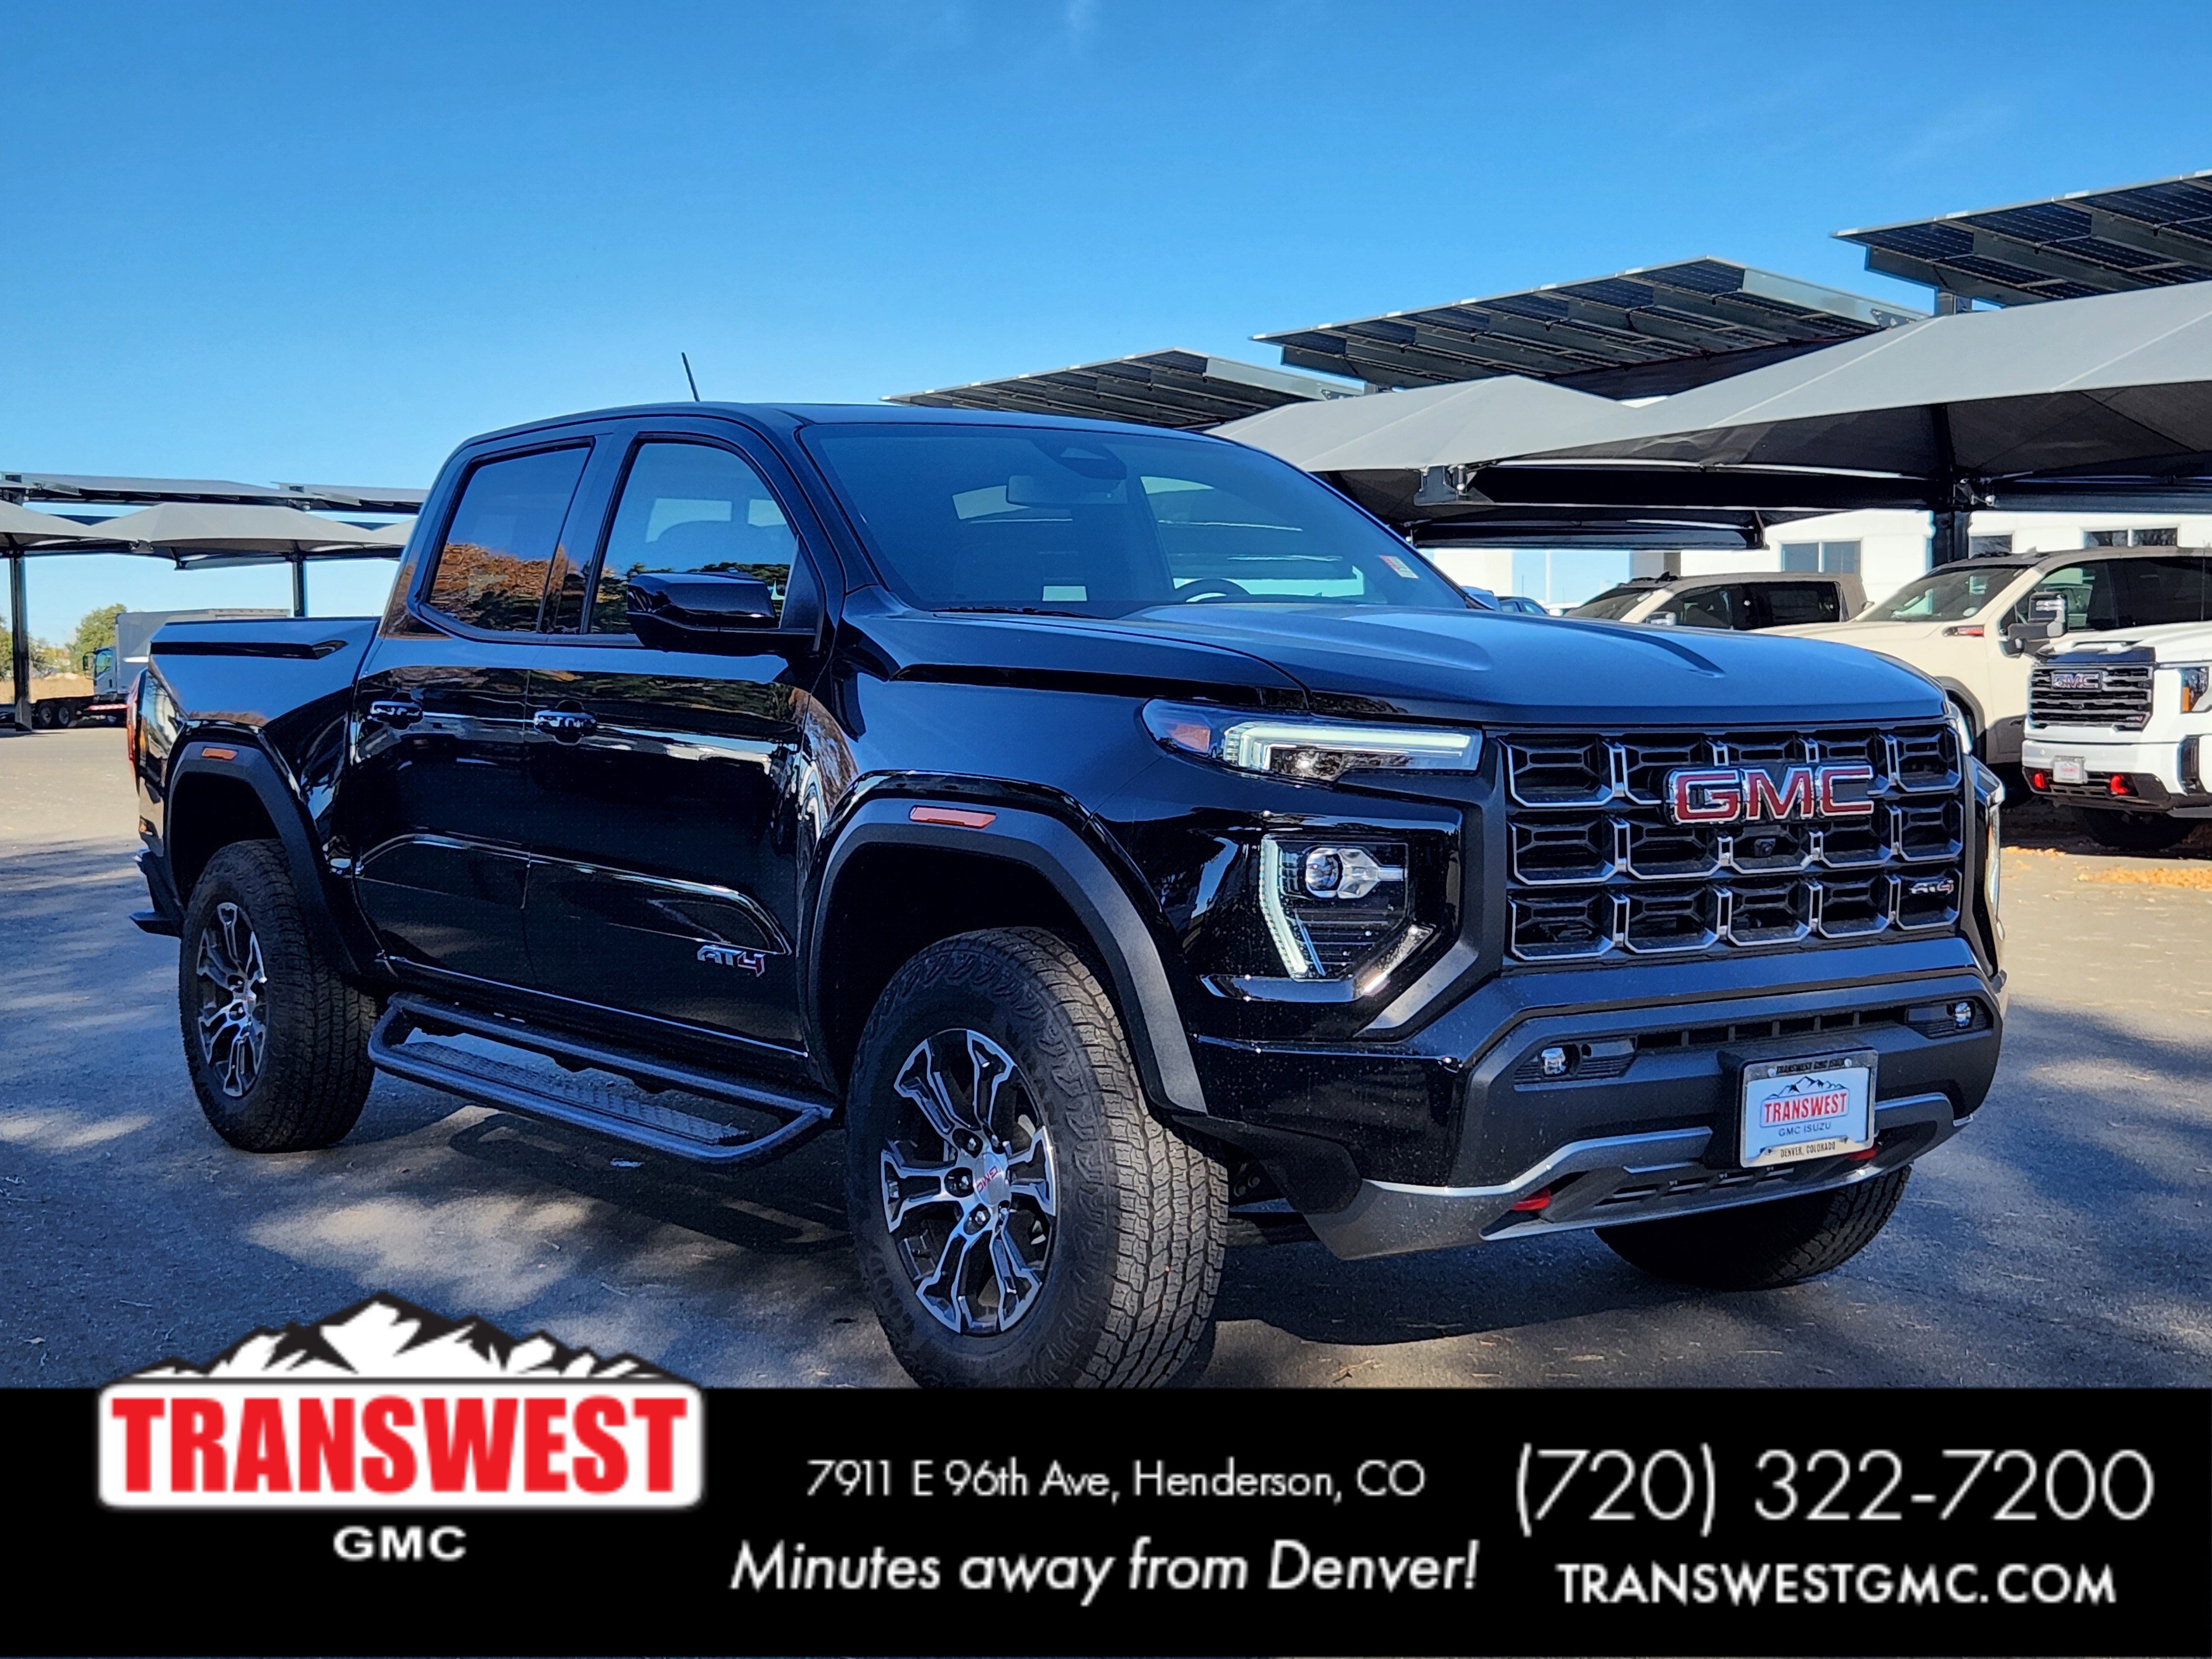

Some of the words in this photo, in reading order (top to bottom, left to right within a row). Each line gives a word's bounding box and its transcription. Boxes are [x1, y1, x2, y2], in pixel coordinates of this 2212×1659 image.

[2053, 673, 2099, 689] GMC
[1669, 765, 1874, 825] GMC
[697, 945, 766, 978] AT4
[1764, 1093, 1847, 1123] TRANSWEST
[1778, 1125, 1801, 1136] GMC
[1803, 1121, 1832, 1134] ISUZU
[1806, 1141, 1836, 1154] COLORADO
[976, 1165, 998, 1193] GMC
